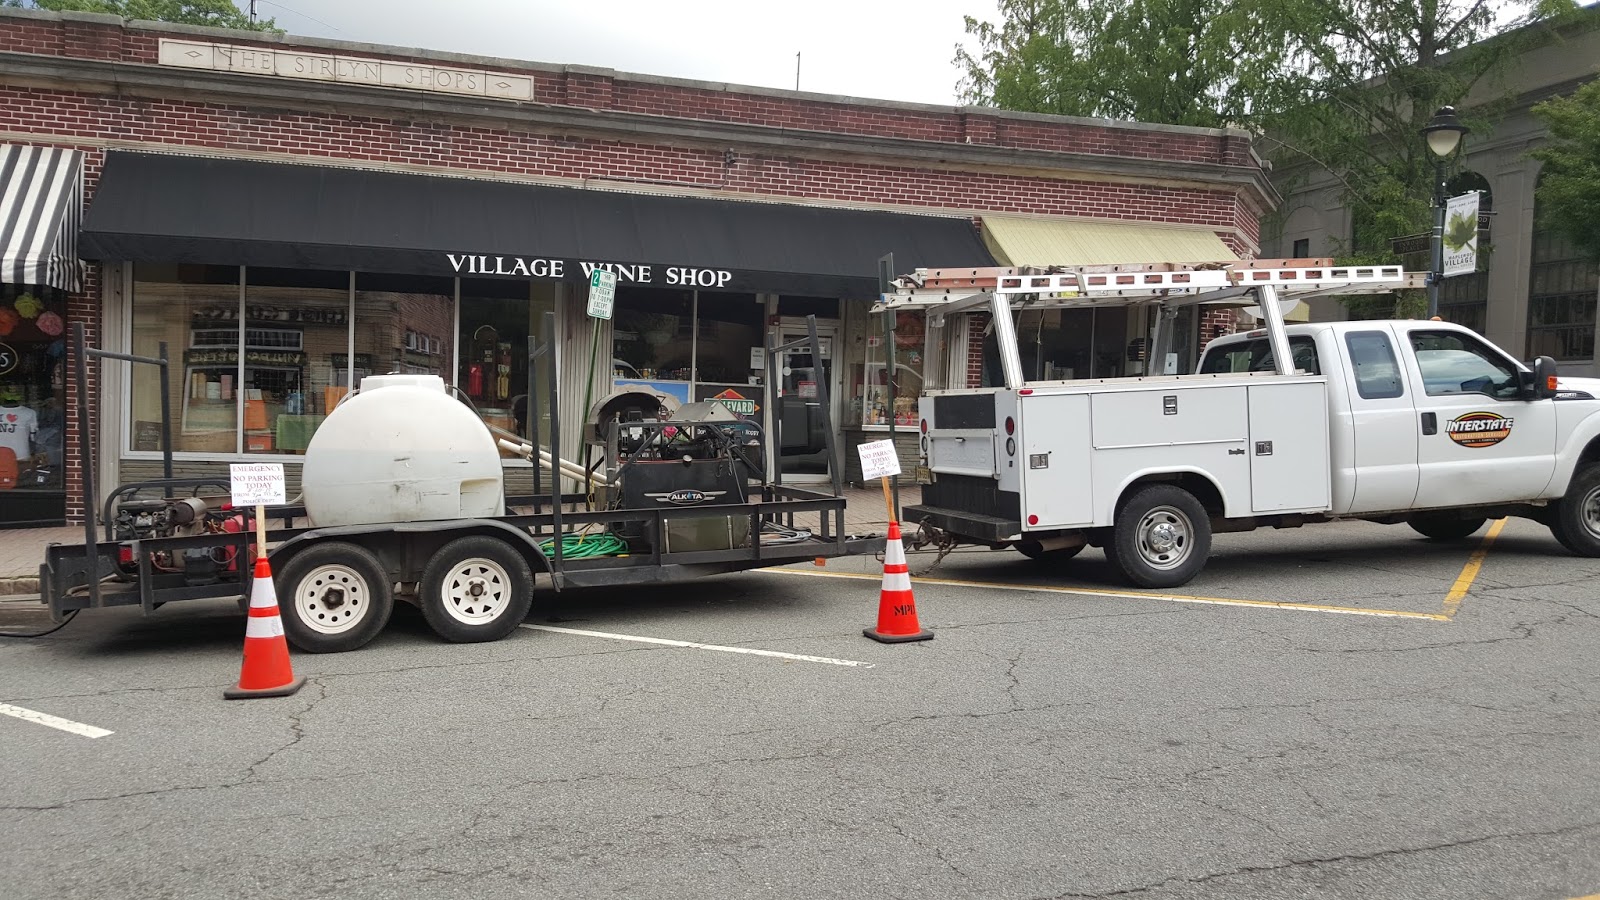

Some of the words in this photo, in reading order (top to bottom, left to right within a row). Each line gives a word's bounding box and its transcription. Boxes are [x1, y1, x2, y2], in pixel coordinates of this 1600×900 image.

[224, 49, 271, 70] THE
[294, 56, 379, 83] SIRLYN
[405, 68, 477, 90] SHOPS
[1444, 255, 1473, 267] VILLAGE
[446, 254, 565, 278] VILLAGE
[665, 267, 733, 288] SHOP
[593, 272, 600, 285] 2
[1445, 417, 1514, 433] INTERSTATE
[232, 465, 281, 473] EMERGENCY
[893, 604, 916, 616] MPD
